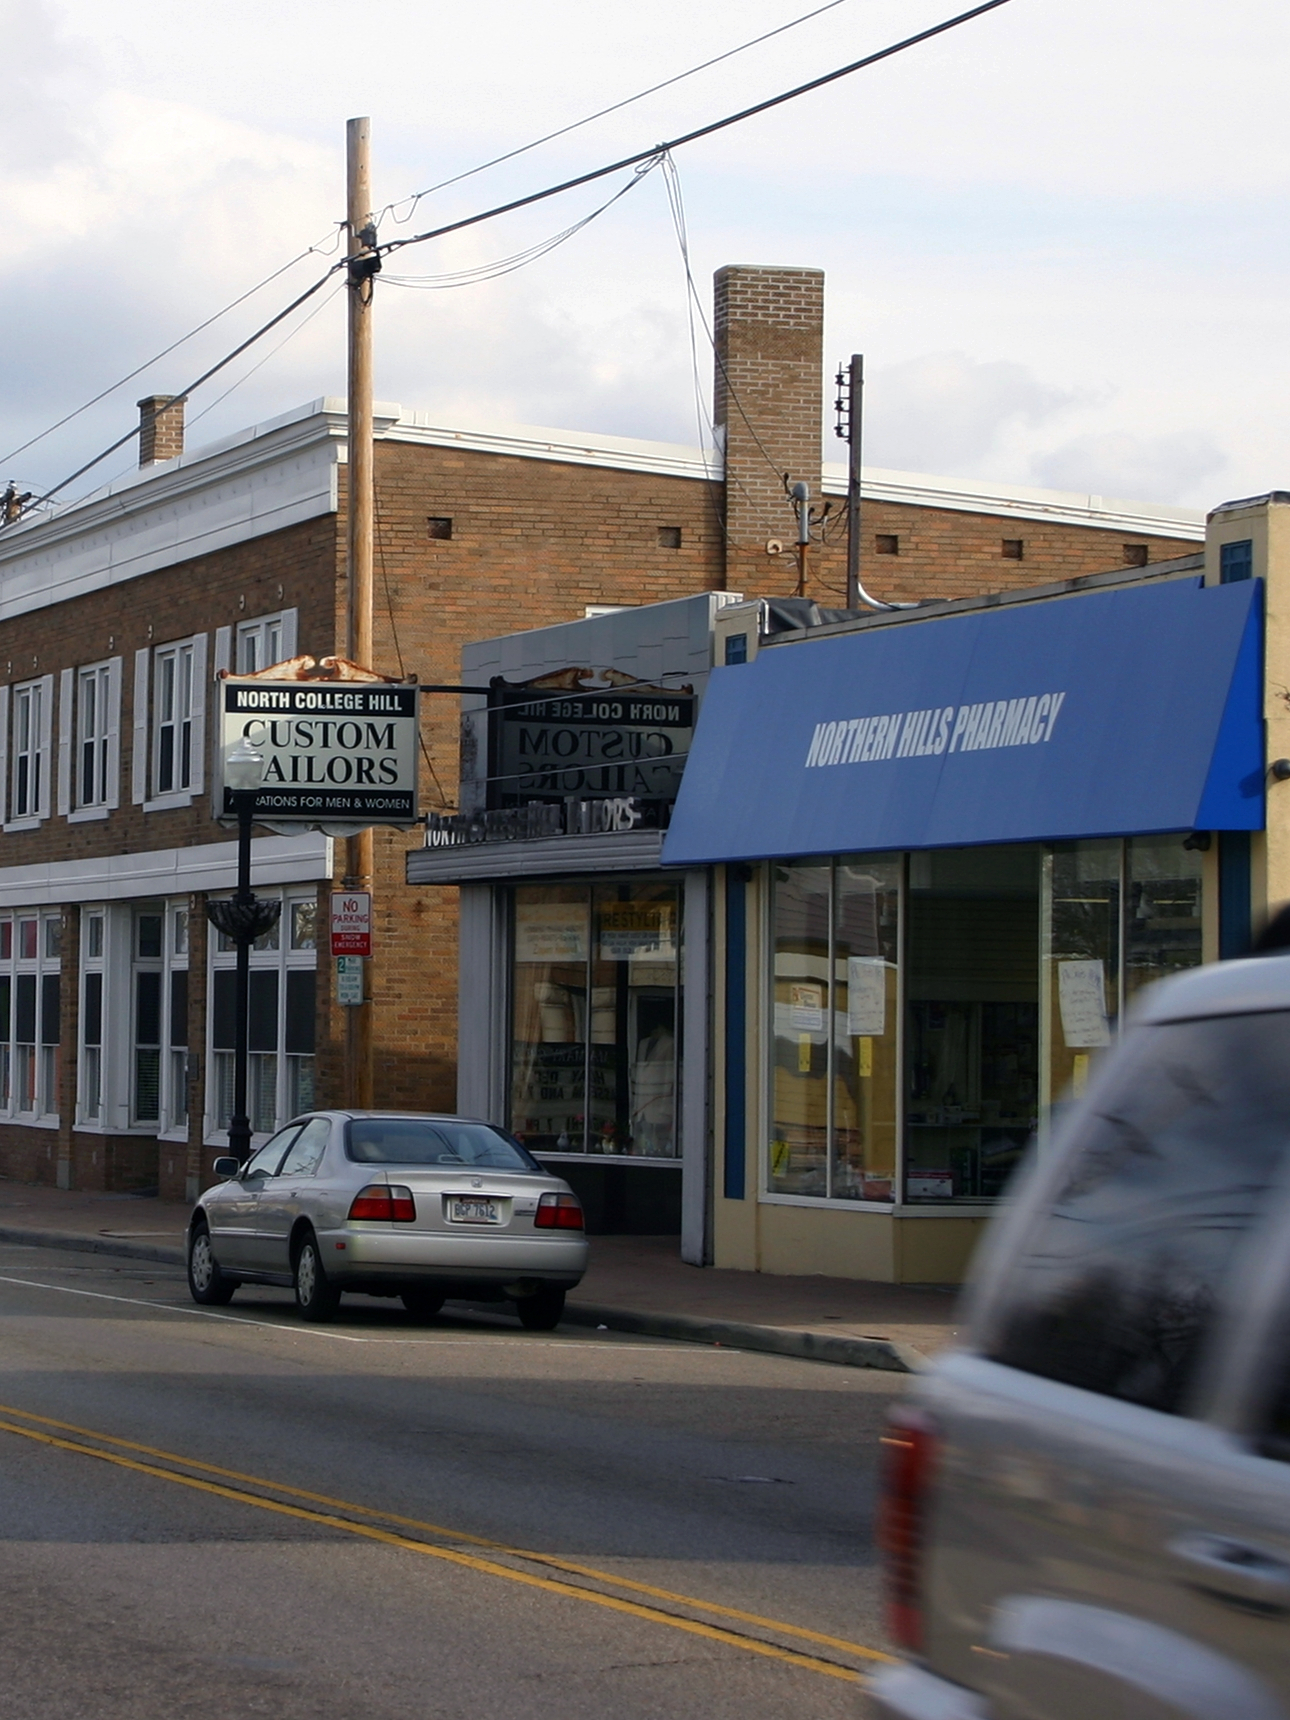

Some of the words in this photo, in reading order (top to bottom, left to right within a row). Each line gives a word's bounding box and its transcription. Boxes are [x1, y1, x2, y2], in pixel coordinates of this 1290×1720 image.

[237, 691, 290, 709] NORTH
[295, 692, 363, 710] COLLEGE
[369, 694, 402, 711] HILL
[242, 718, 397, 750] CUSTOM
[805, 713, 903, 768] NORTHERN
[895, 706, 954, 759] HILLS
[948, 692, 1066, 753] PHARMACY
[259, 754, 399, 785] AILORS
[300, 796, 322, 808] FOR
[326, 797, 351, 808] MEN
[354, 797, 362, 809] &
[365, 798, 410, 809] WOMEN
[342, 899, 359, 913] NO
[332, 914, 369, 923] PARKING
[338, 958, 344, 971] 2
